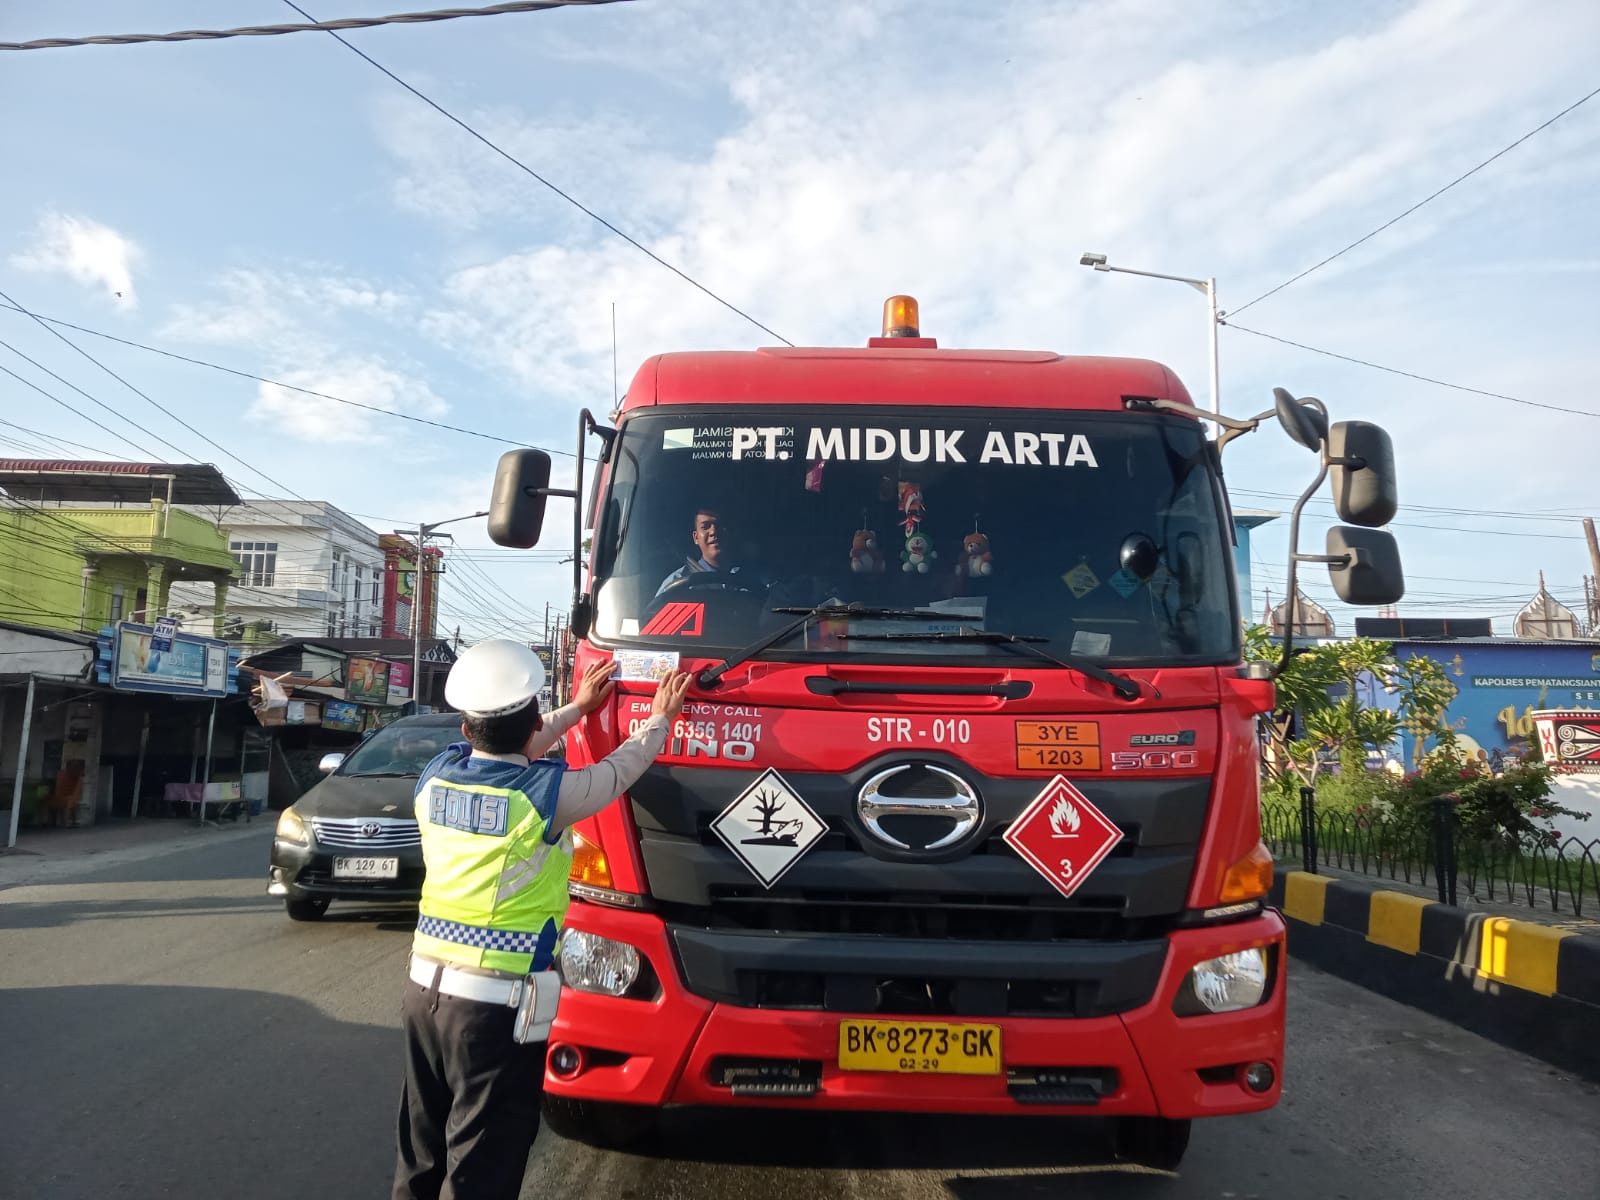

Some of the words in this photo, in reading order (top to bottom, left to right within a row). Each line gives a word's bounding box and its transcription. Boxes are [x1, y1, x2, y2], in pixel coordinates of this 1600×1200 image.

[731, 427, 789, 460] PT.
[806, 427, 967, 463] MIDUK
[979, 431, 1099, 467] ARTA
[155, 626, 174, 636] ATM
[1474, 678, 1524, 687] KAPOLRES
[630, 702, 721, 715] EMENCY
[724, 706, 762, 717] CALL
[674, 720, 716, 740] 6356
[721, 721, 762, 742] 1401
[867, 717, 913, 742] STR
[932, 718, 970, 744] 010
[1038, 726, 1079, 741] 3YE
[1130, 734, 1179, 744] EURO
[660, 737, 756, 762] INO
[1036, 749, 1084, 766] 1203
[1111, 750, 1200, 770] 500
[430, 790, 506, 832] POLISI
[336, 859, 350, 870] BK
[356, 859, 375, 870] 129
[1060, 859, 1073, 878] 3
[847, 1025, 877, 1053] BK
[886, 1026, 949, 1056] 8273
[962, 1029, 994, 1057] GK
